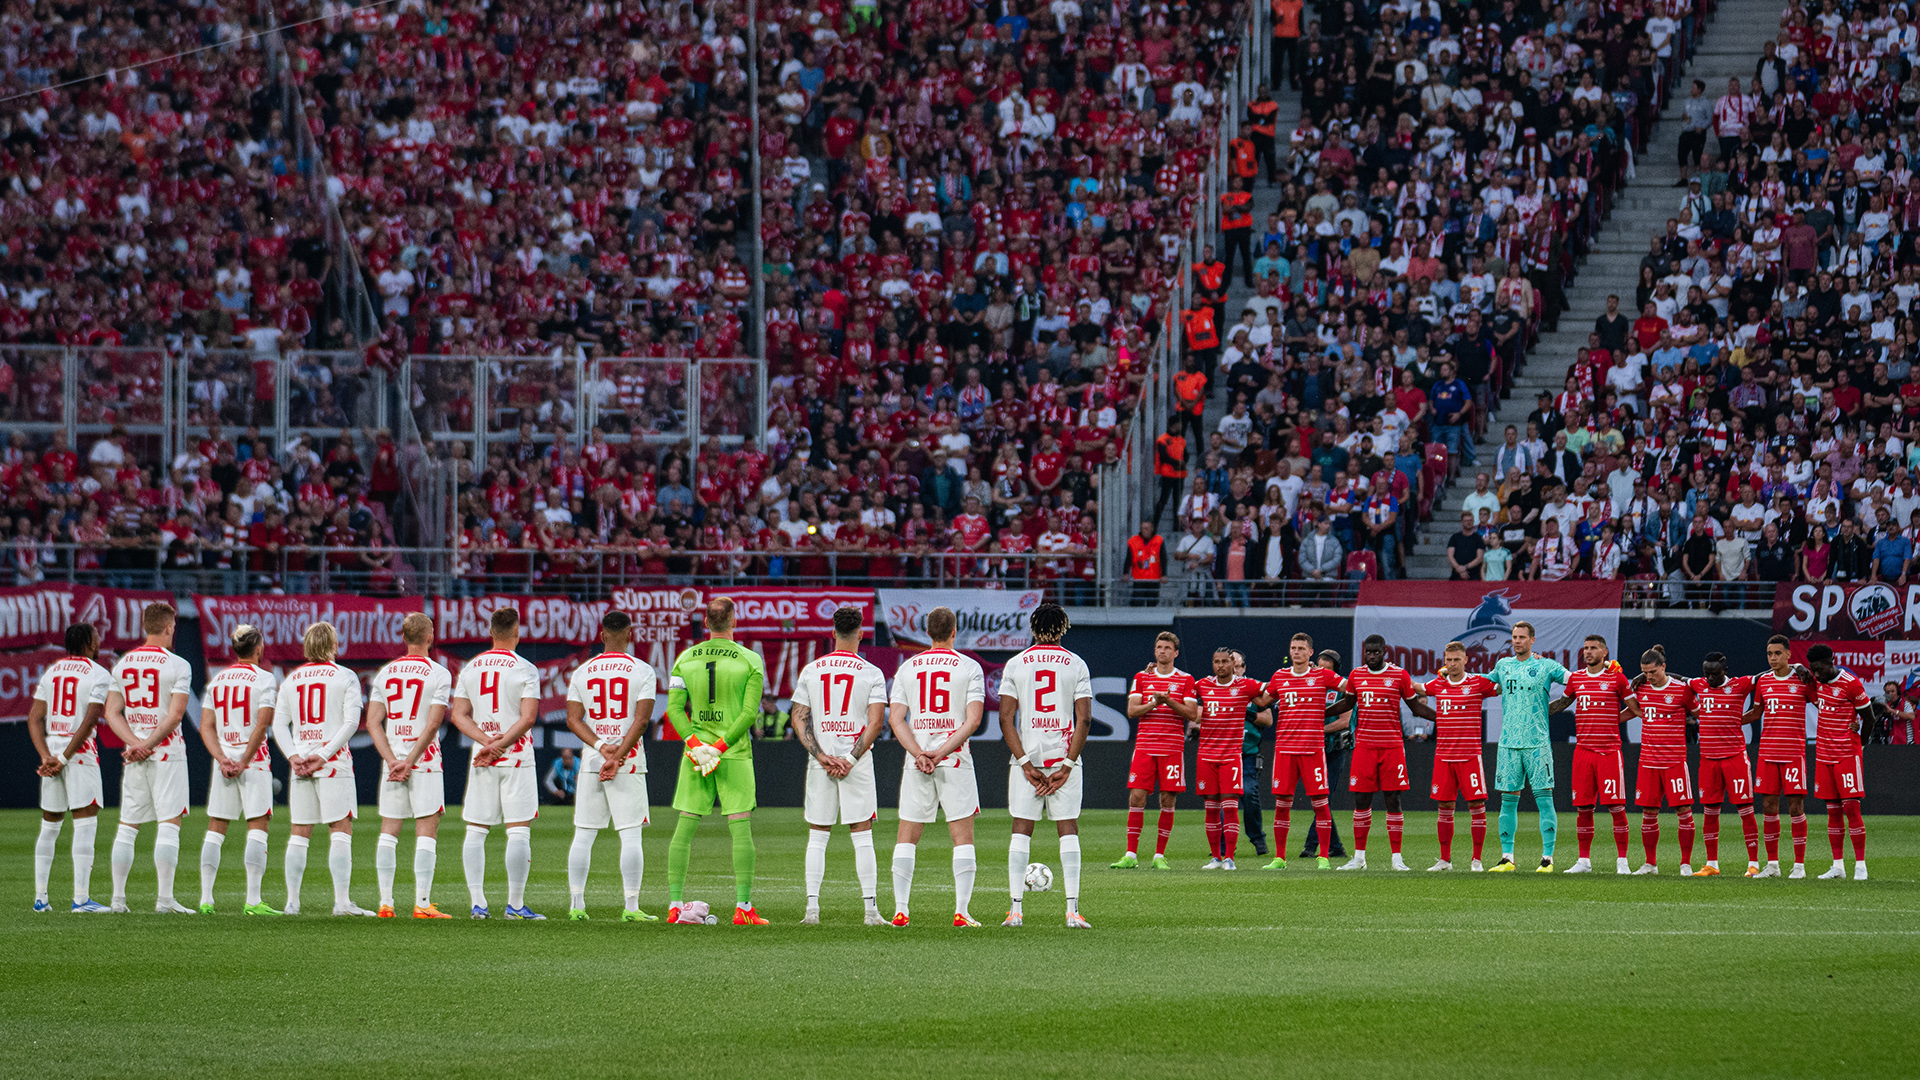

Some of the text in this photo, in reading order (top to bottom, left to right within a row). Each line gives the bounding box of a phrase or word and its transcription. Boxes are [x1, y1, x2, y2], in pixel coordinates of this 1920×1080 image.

[613, 588, 707, 612] SÜDTIROL
[733, 600, 809, 620] RIGADE
[628, 612, 690, 626] LETZTE
[1870, 618, 1895, 634] Leipzig
[634, 626, 681, 643] REIHE
[125, 655, 168, 665] RB LEIPZIG
[692, 648, 739, 659] RB LEIPZIG
[1023, 654, 1071, 666] RB LEIPZIG
[53, 663, 92, 675] RB LEIPZIG
[473, 658, 516, 669] RB LEIPZIG
[587, 663, 633, 674] RB LEIPZIG
[816, 659, 864, 671] RB LEIPZIG
[912, 657, 960, 668] RB LEIPZIG
[217, 673, 258, 683] RB LEIPZIG
[292, 669, 336, 681] RB LEIPZIG
[388, 665, 431, 677] RB LEIPZIG
[122, 668, 160, 709] 23
[704, 660, 717, 705] 1
[52, 676, 80, 718] 18
[385, 677, 425, 720] 27
[479, 670, 501, 714] 4
[586, 676, 630, 721] 39
[820, 672, 855, 717] 17
[916, 670, 951, 714] 16
[1034, 669, 1057, 713] 2
[213, 685, 252, 727] 44
[297, 682, 326, 726] 10
[699, 707, 724, 722] GULÁCSI
[1166, 764, 1180, 780] 25
[1231, 766, 1239, 781] 7
[1314, 767, 1323, 782] 5
[1397, 764, 1405, 779] 2
[1784, 767, 1799, 783] 42
[1470, 772, 1479, 788] 6
[1603, 779, 1616, 794] 21
[1670, 777, 1684, 794] 18
[1732, 778, 1745, 794] 17
[1841, 772, 1855, 788] 19
